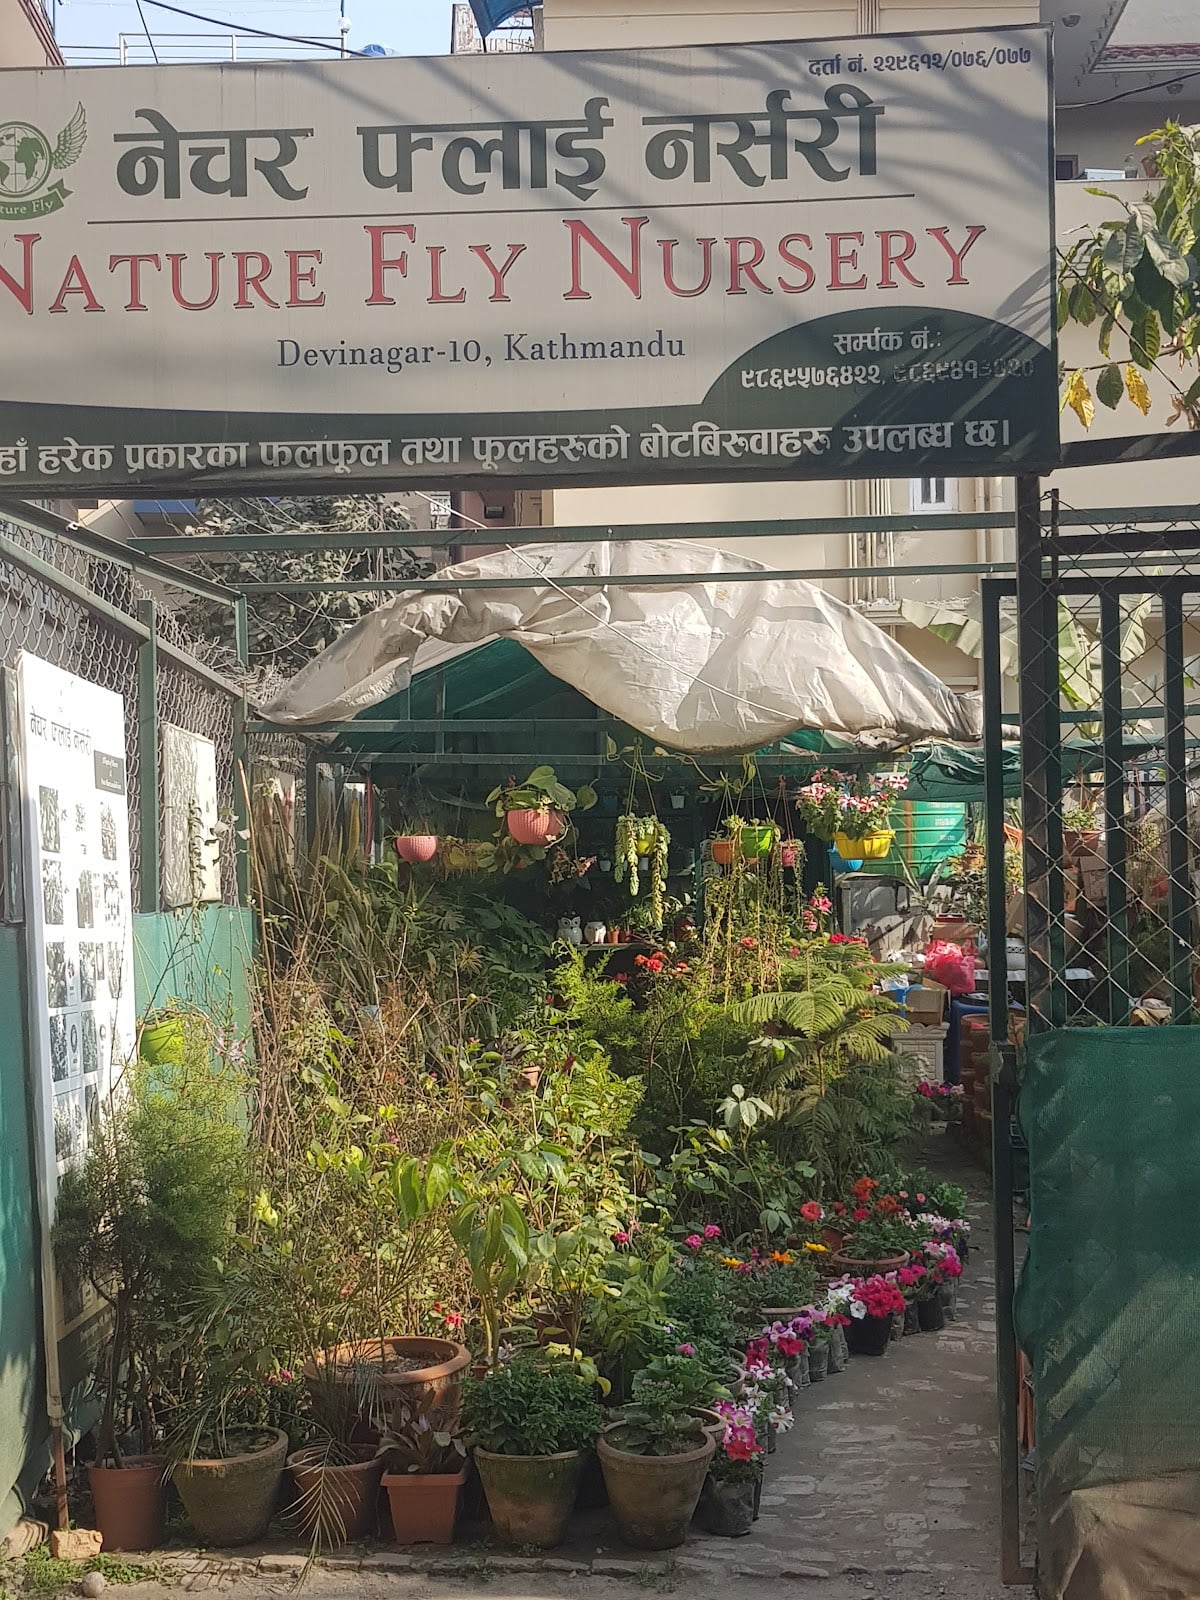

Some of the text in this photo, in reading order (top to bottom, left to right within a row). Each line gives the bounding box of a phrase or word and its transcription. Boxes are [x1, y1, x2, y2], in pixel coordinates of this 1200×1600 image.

[808, 53, 841, 76] दर्ता
[847, 53, 867, 73] नं.
[113, 83, 885, 202] नेचर फ्लाई नर्सरी
[363, 224, 527, 305] FLY
[562, 216, 987, 300] NURSERY
[277, 330, 685, 374] Devinagar-10, Kathmandu
[38, 437, 115, 474] हरेक
[124, 442, 250, 474] प्रकारका
[258, 439, 392, 474] फलफूल
[401, 437, 462, 466] तथा
[842, 422, 954, 453] उपलब्ध
[964, 419, 1010, 447] छ।
